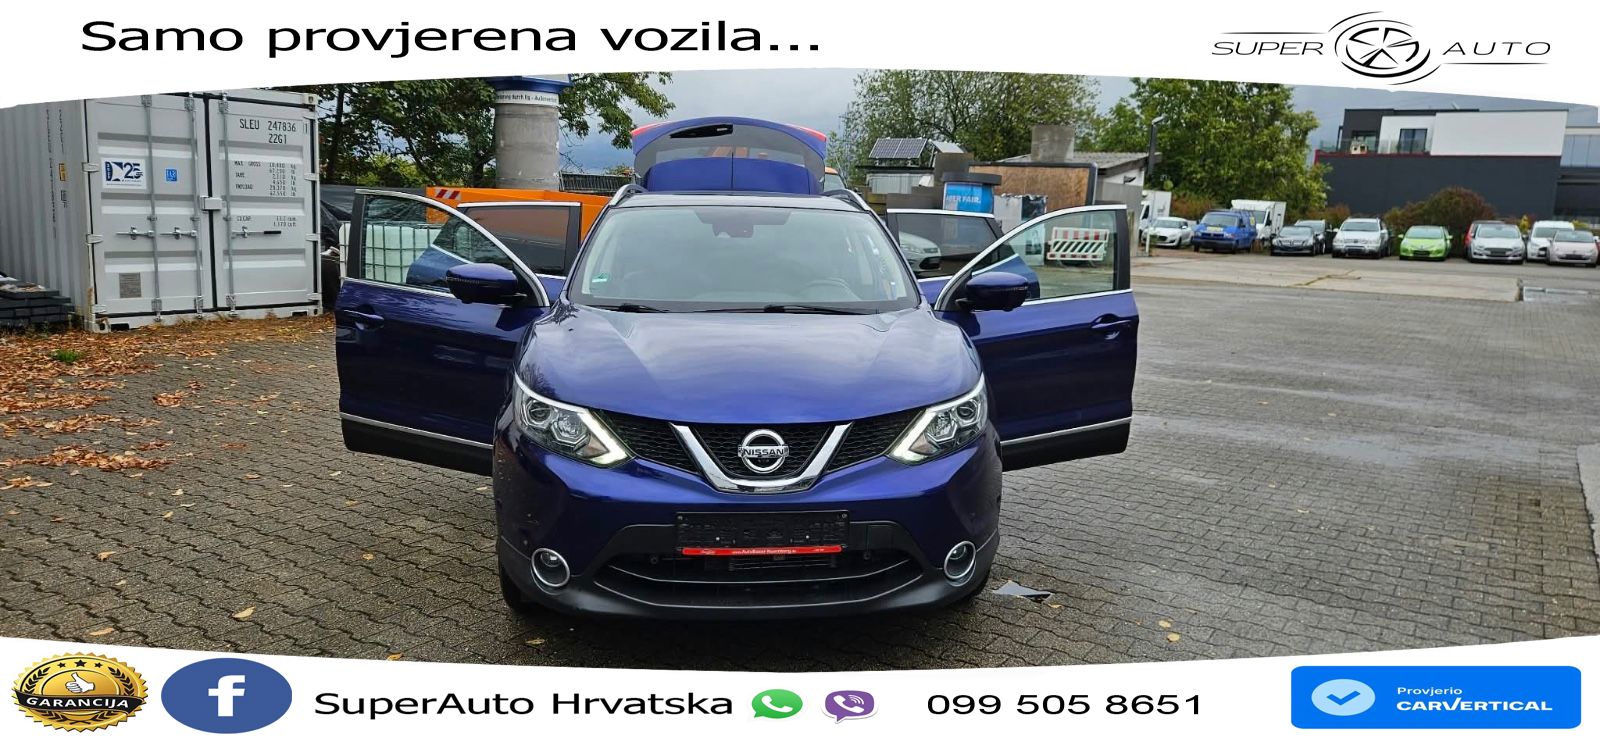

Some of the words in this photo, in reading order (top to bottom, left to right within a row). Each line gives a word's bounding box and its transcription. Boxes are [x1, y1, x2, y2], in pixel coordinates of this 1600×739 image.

[240, 119, 260, 130] SLEU
[268, 121, 296, 132] 247836
[268, 134, 287, 144] 22G1
